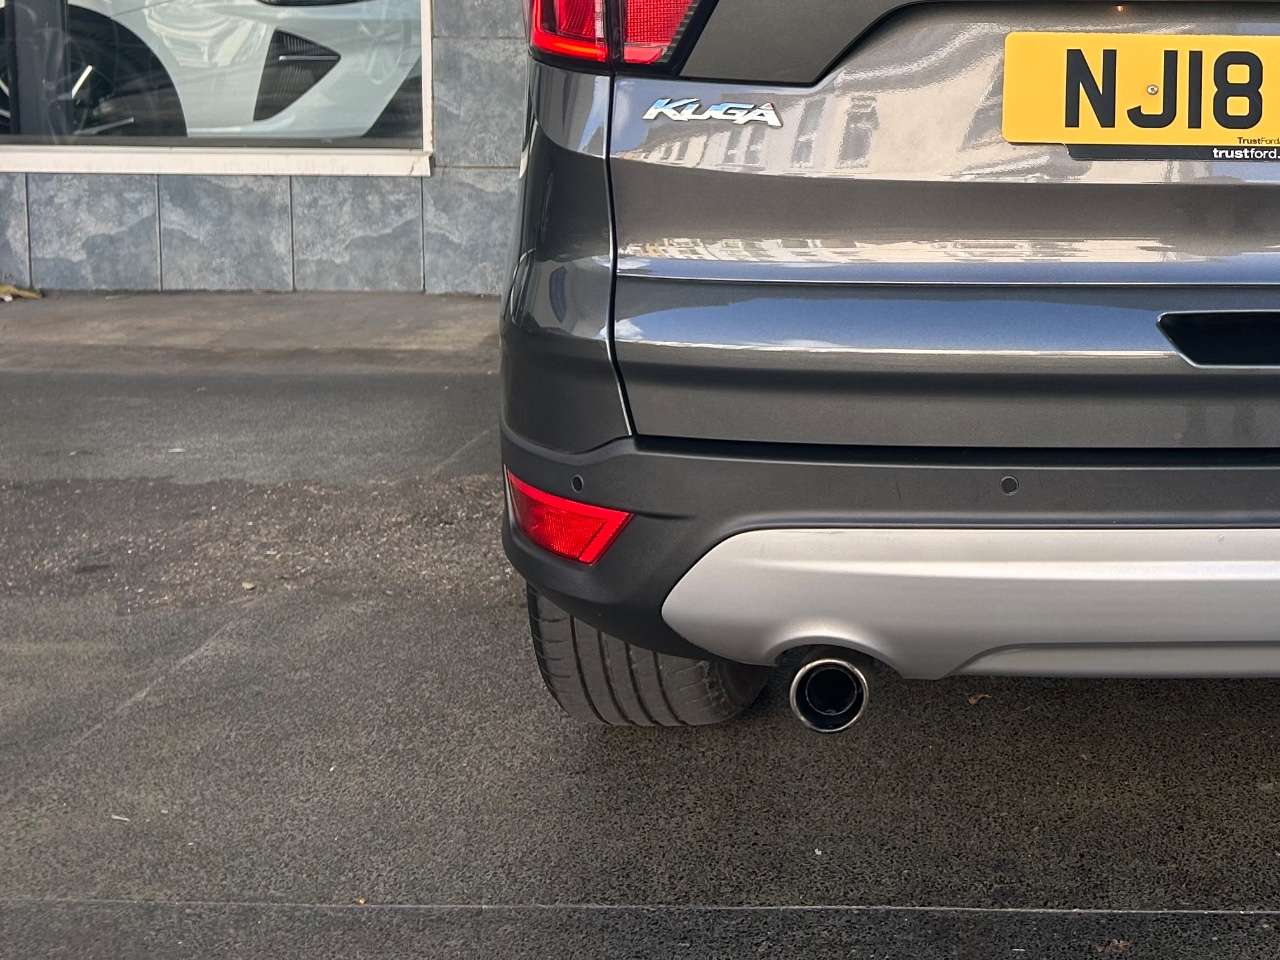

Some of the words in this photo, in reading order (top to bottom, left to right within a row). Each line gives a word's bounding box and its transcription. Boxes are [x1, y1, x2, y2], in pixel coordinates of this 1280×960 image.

[1064, 48, 1264, 130] NJ18
[642, 98, 783, 127] KUGA
[1237, 136, 1280, 145] TrustFord
